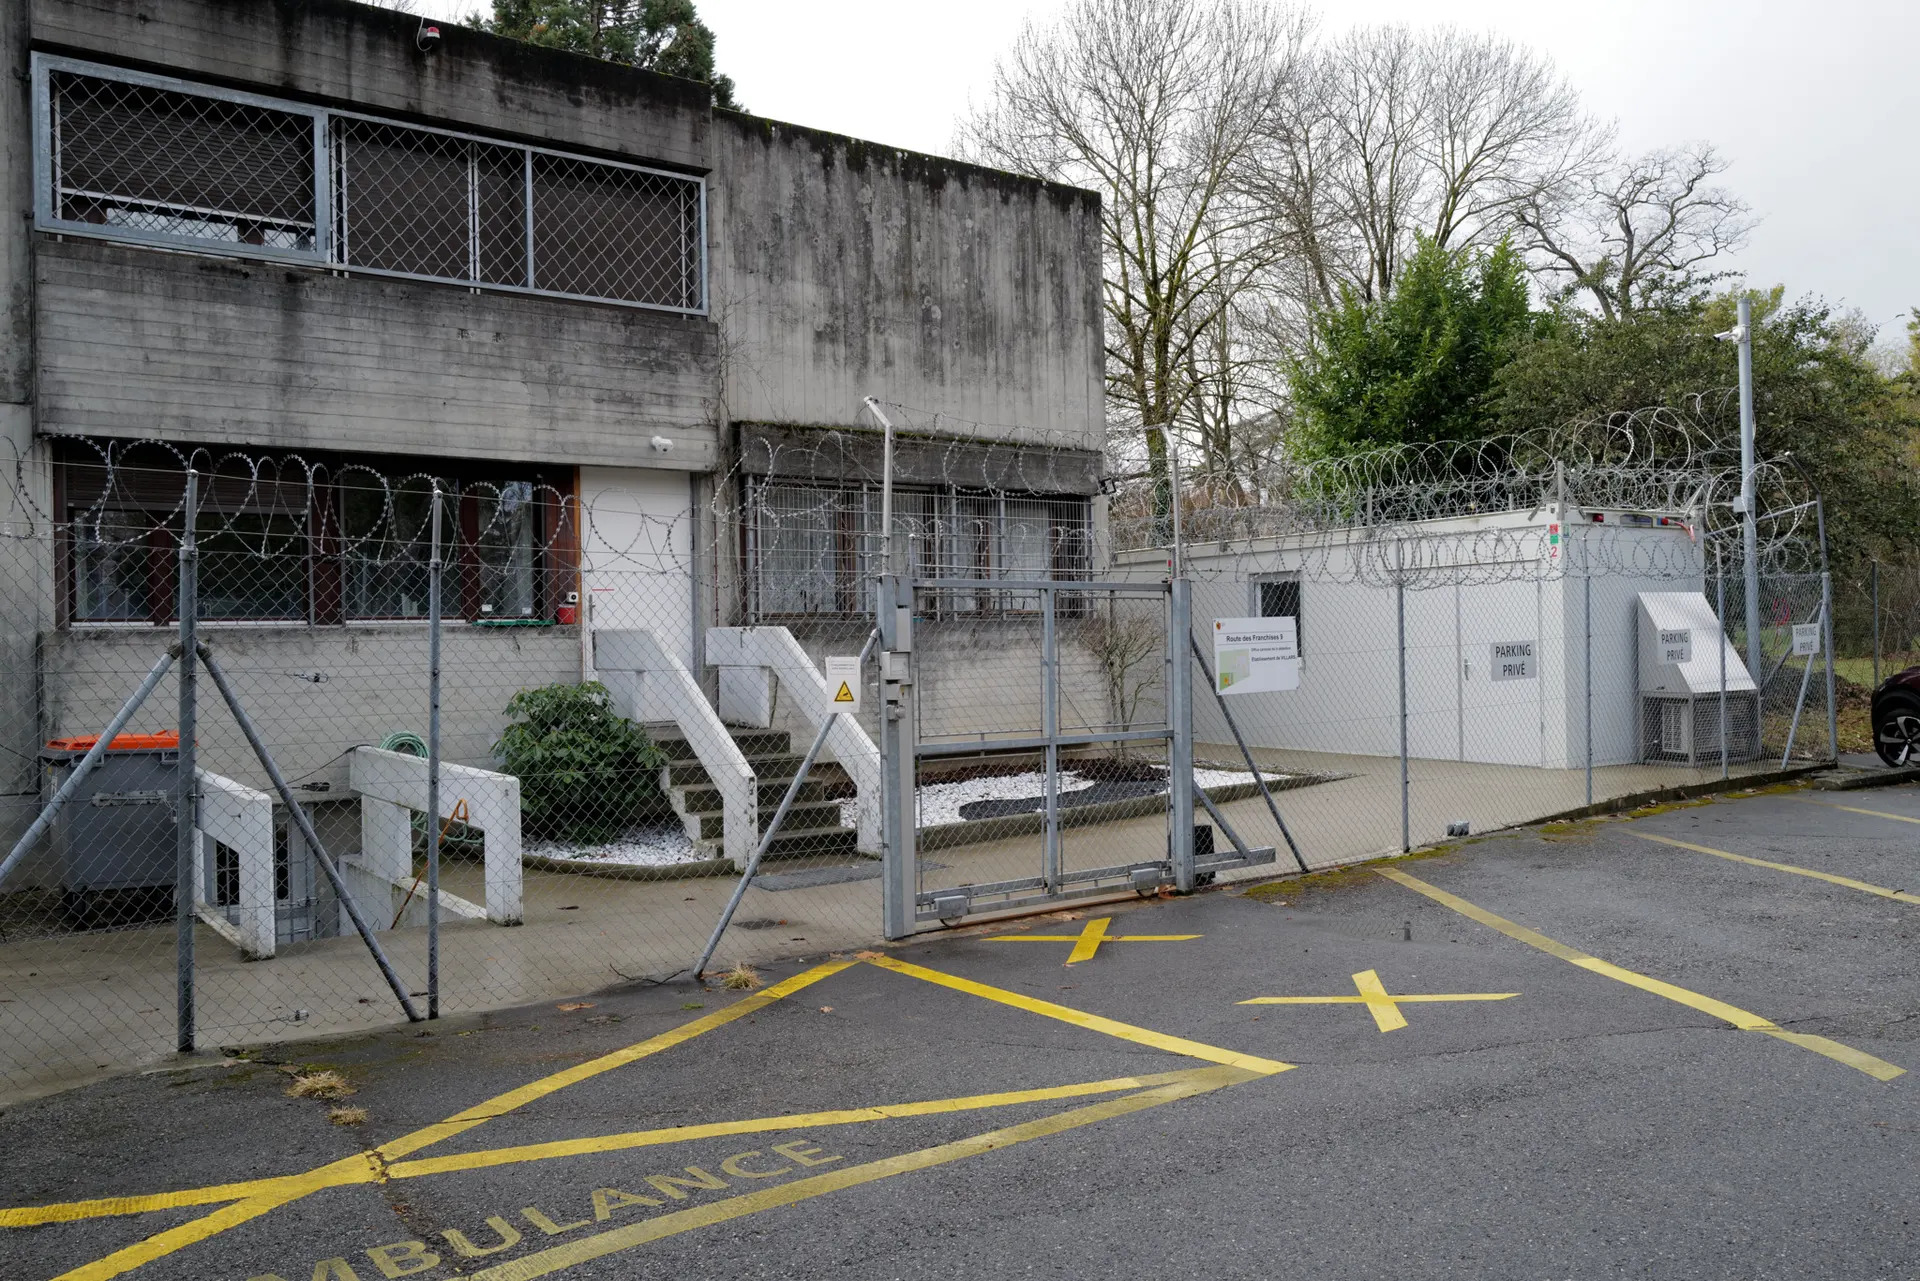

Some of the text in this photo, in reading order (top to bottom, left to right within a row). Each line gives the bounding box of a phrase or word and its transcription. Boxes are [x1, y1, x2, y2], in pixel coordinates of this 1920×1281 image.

[1551, 546, 1557, 558] 2
[1253, 633, 1279, 641] Franchises
[1661, 632, 1689, 645] PARKING
[1495, 644, 1532, 658] PARKING
[1503, 660, 1525, 677] PRIVÉ
